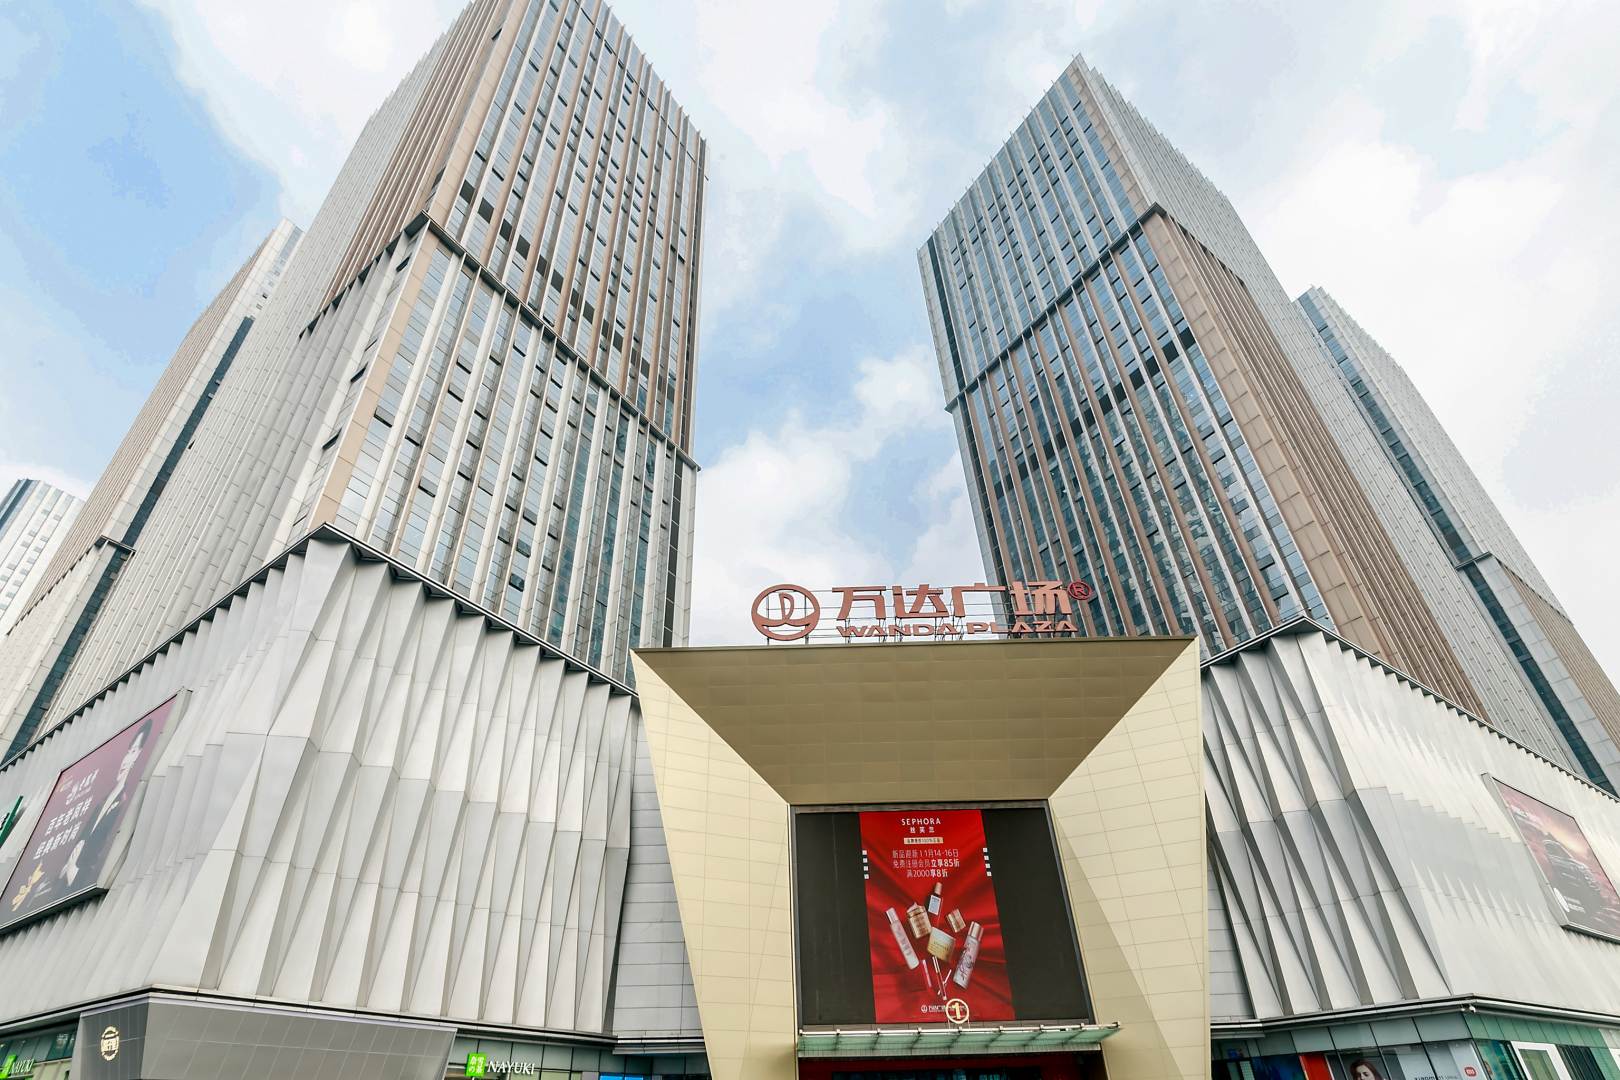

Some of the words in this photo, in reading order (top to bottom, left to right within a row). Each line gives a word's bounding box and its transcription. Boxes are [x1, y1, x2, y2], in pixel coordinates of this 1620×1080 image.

[832, 581, 1073, 620] 万达广场
[836, 622, 954, 637] WANDA
[967, 620, 1079, 635] PLAZA
[901, 817, 941, 826] SEPHORA
[487, 1060, 536, 1075] NAYUKI
